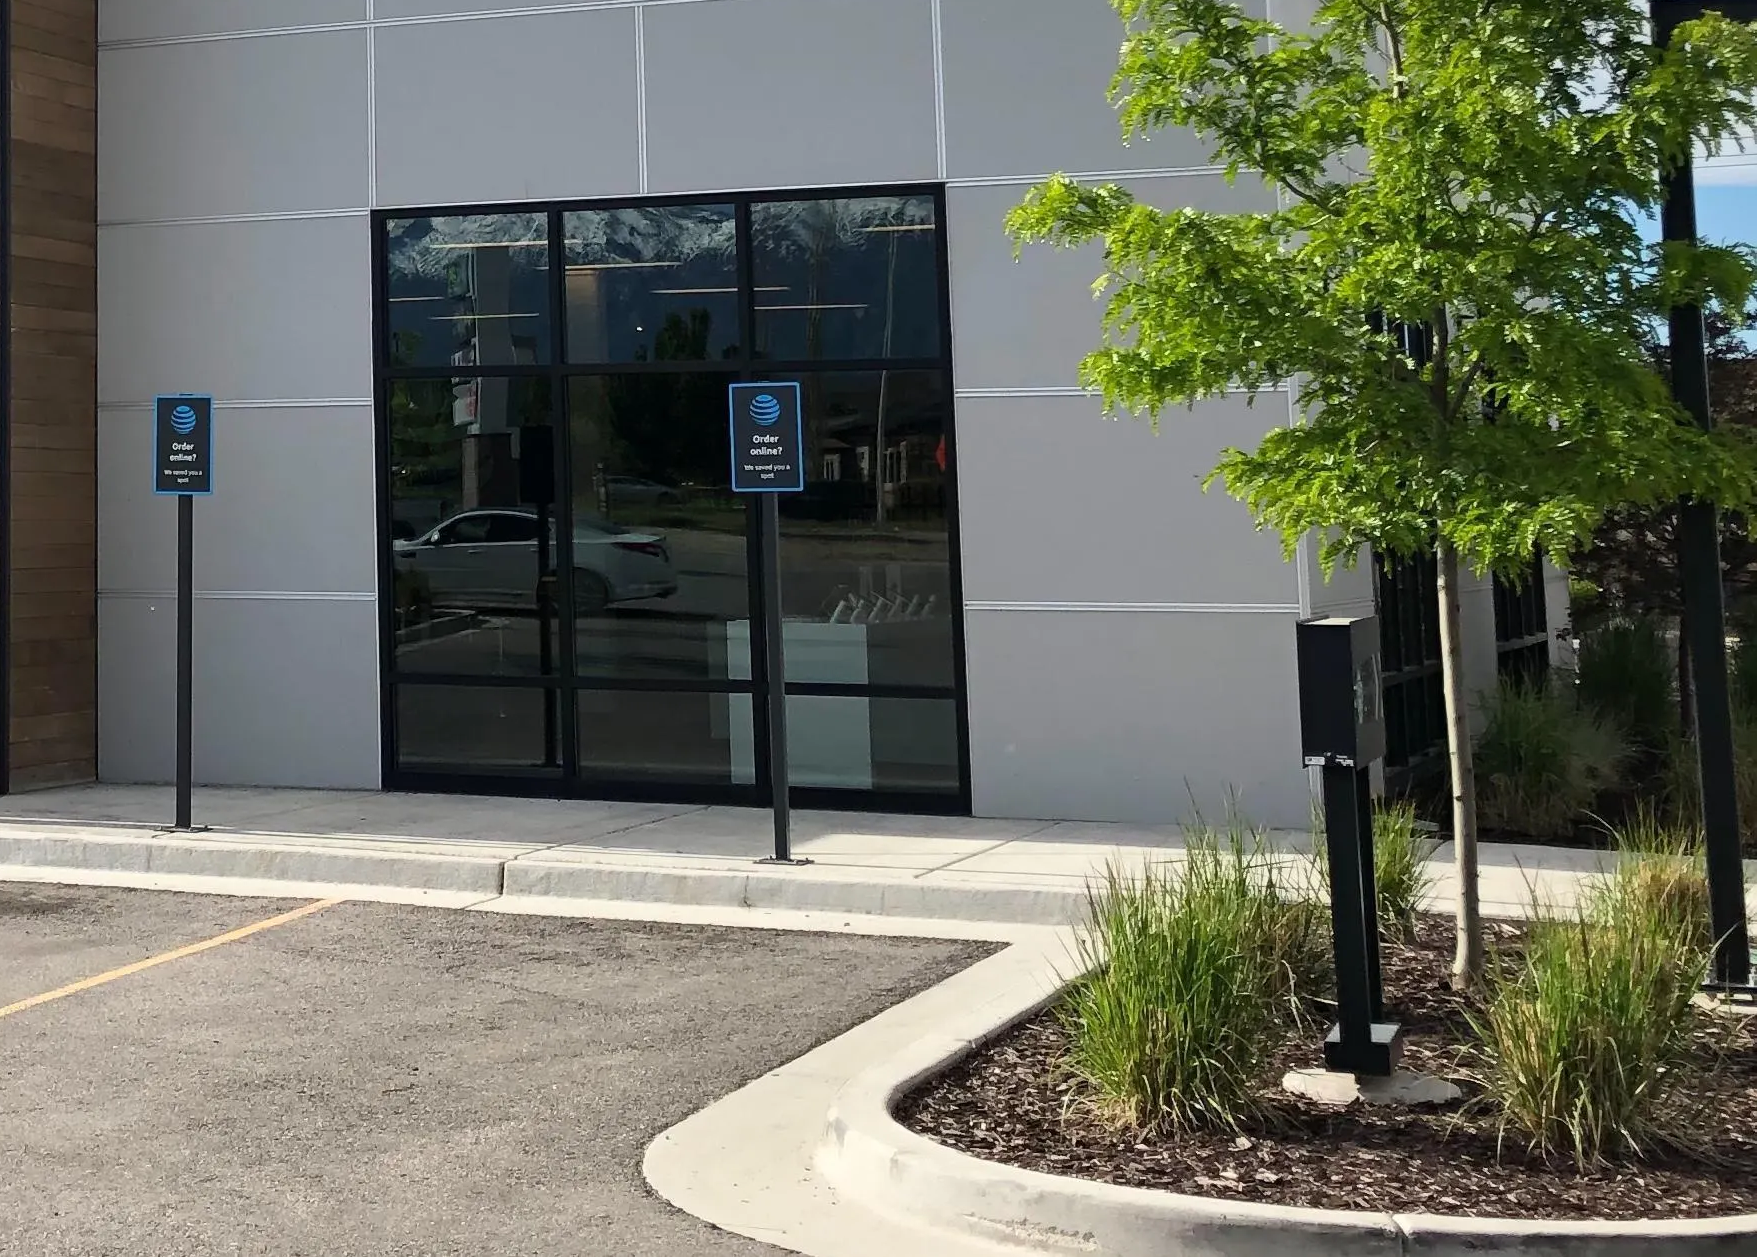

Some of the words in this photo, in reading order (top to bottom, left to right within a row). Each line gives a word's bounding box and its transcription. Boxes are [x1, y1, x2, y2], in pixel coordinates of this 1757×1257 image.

[752, 434, 780, 444] Order
[171, 442, 195, 451] Order
[749, 446, 783, 456] online?
[169, 453, 197, 462] online?
